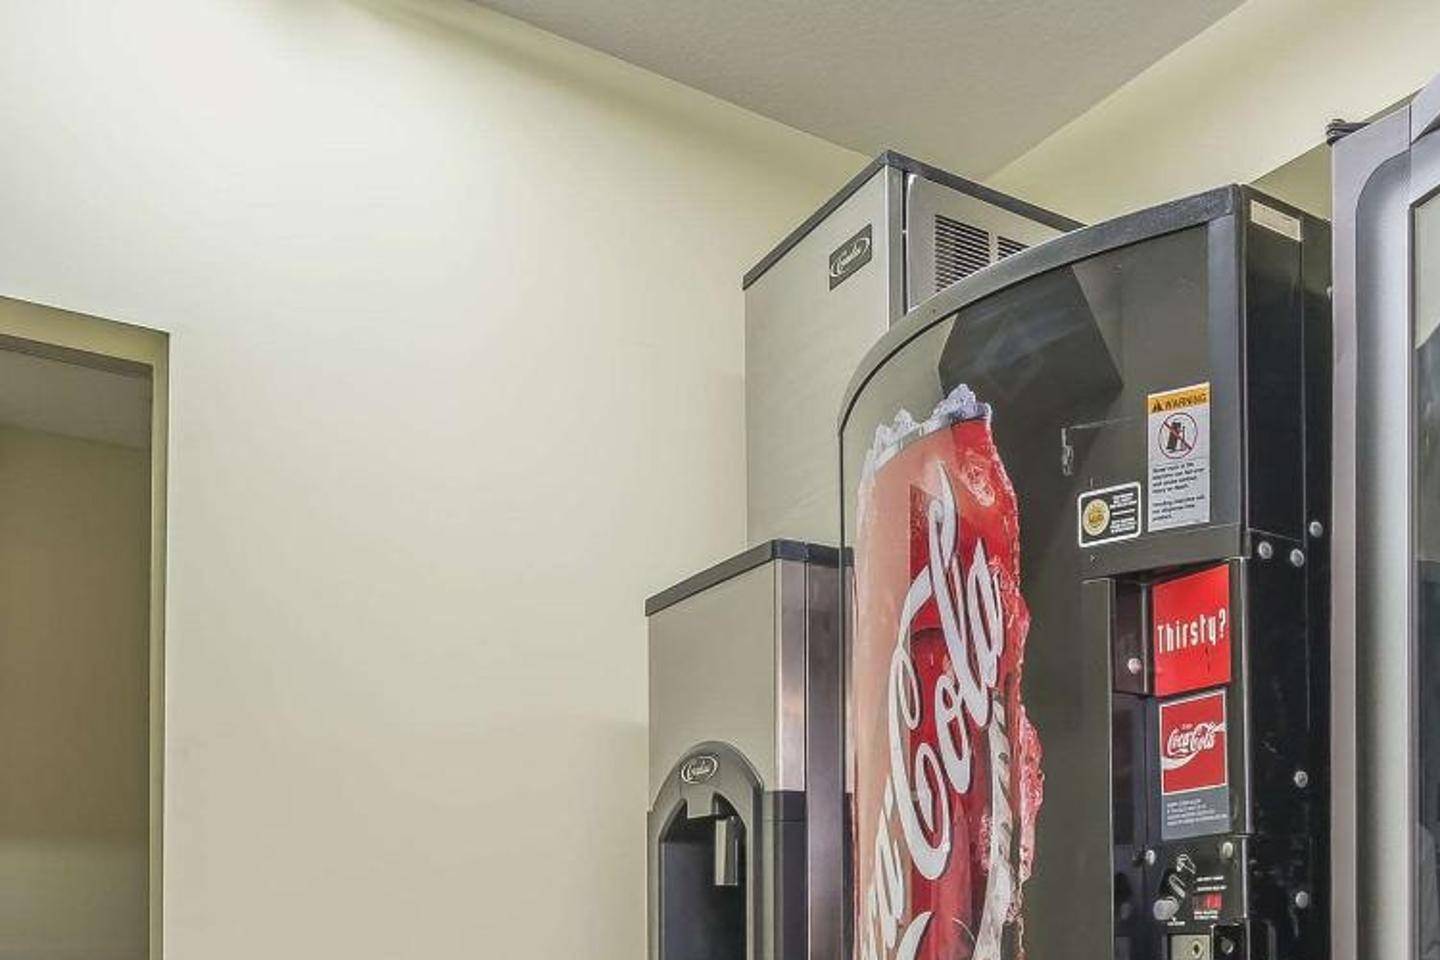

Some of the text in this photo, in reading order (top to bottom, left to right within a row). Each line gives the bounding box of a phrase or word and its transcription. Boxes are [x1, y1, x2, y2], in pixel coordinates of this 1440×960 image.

[1165, 393, 1207, 411] WARNING
[1157, 607, 1228, 655] Thirsty?
[1166, 721, 1216, 757] Coca-Cola
